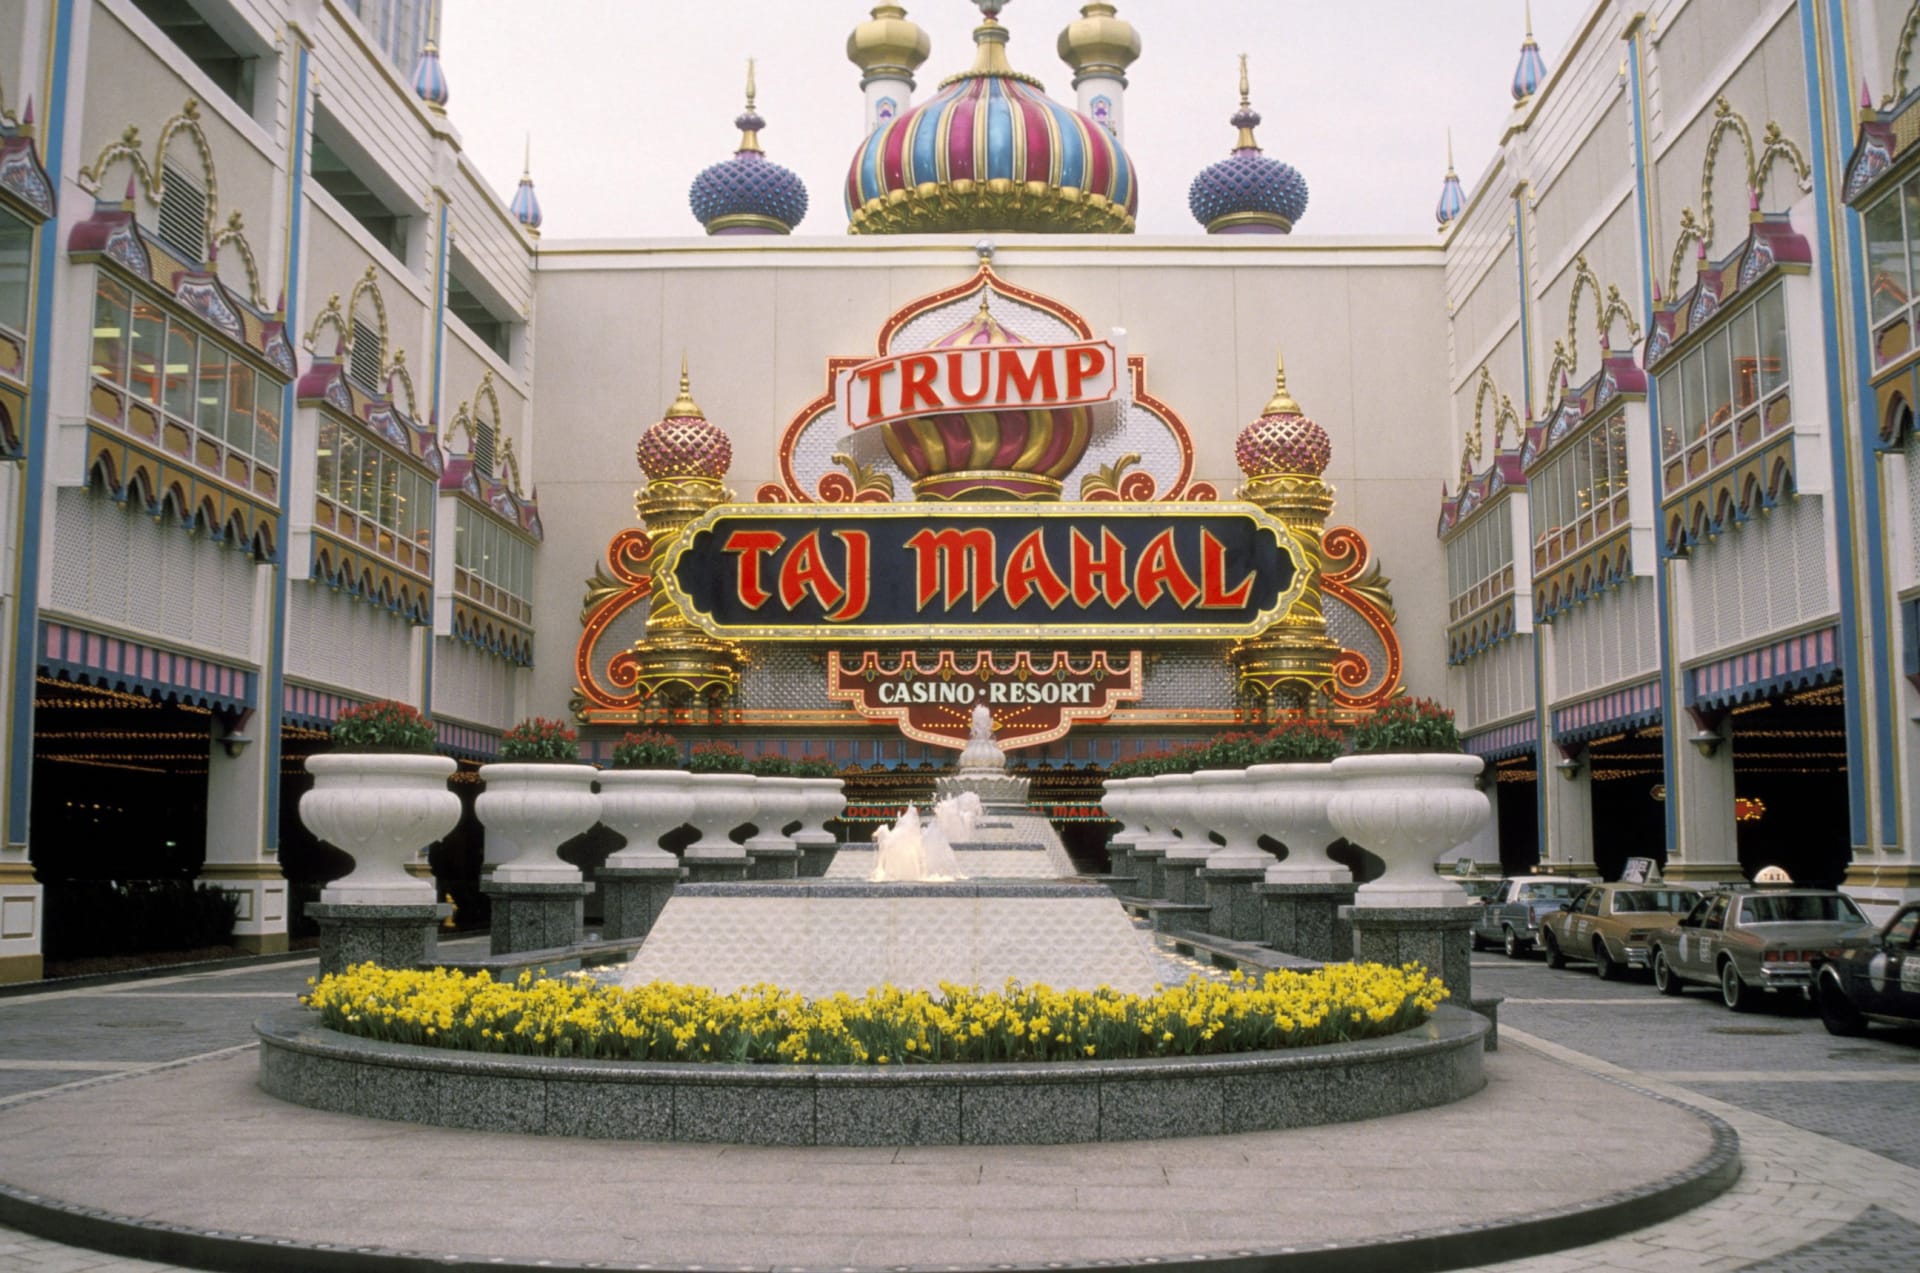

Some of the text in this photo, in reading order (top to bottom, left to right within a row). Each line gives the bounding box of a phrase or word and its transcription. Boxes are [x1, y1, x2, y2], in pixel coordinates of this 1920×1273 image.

[857, 347, 1106, 419] TRUMP
[721, 525, 1257, 622] TAJ MAHAL
[878, 682, 1096, 704] CASINO RESORT
